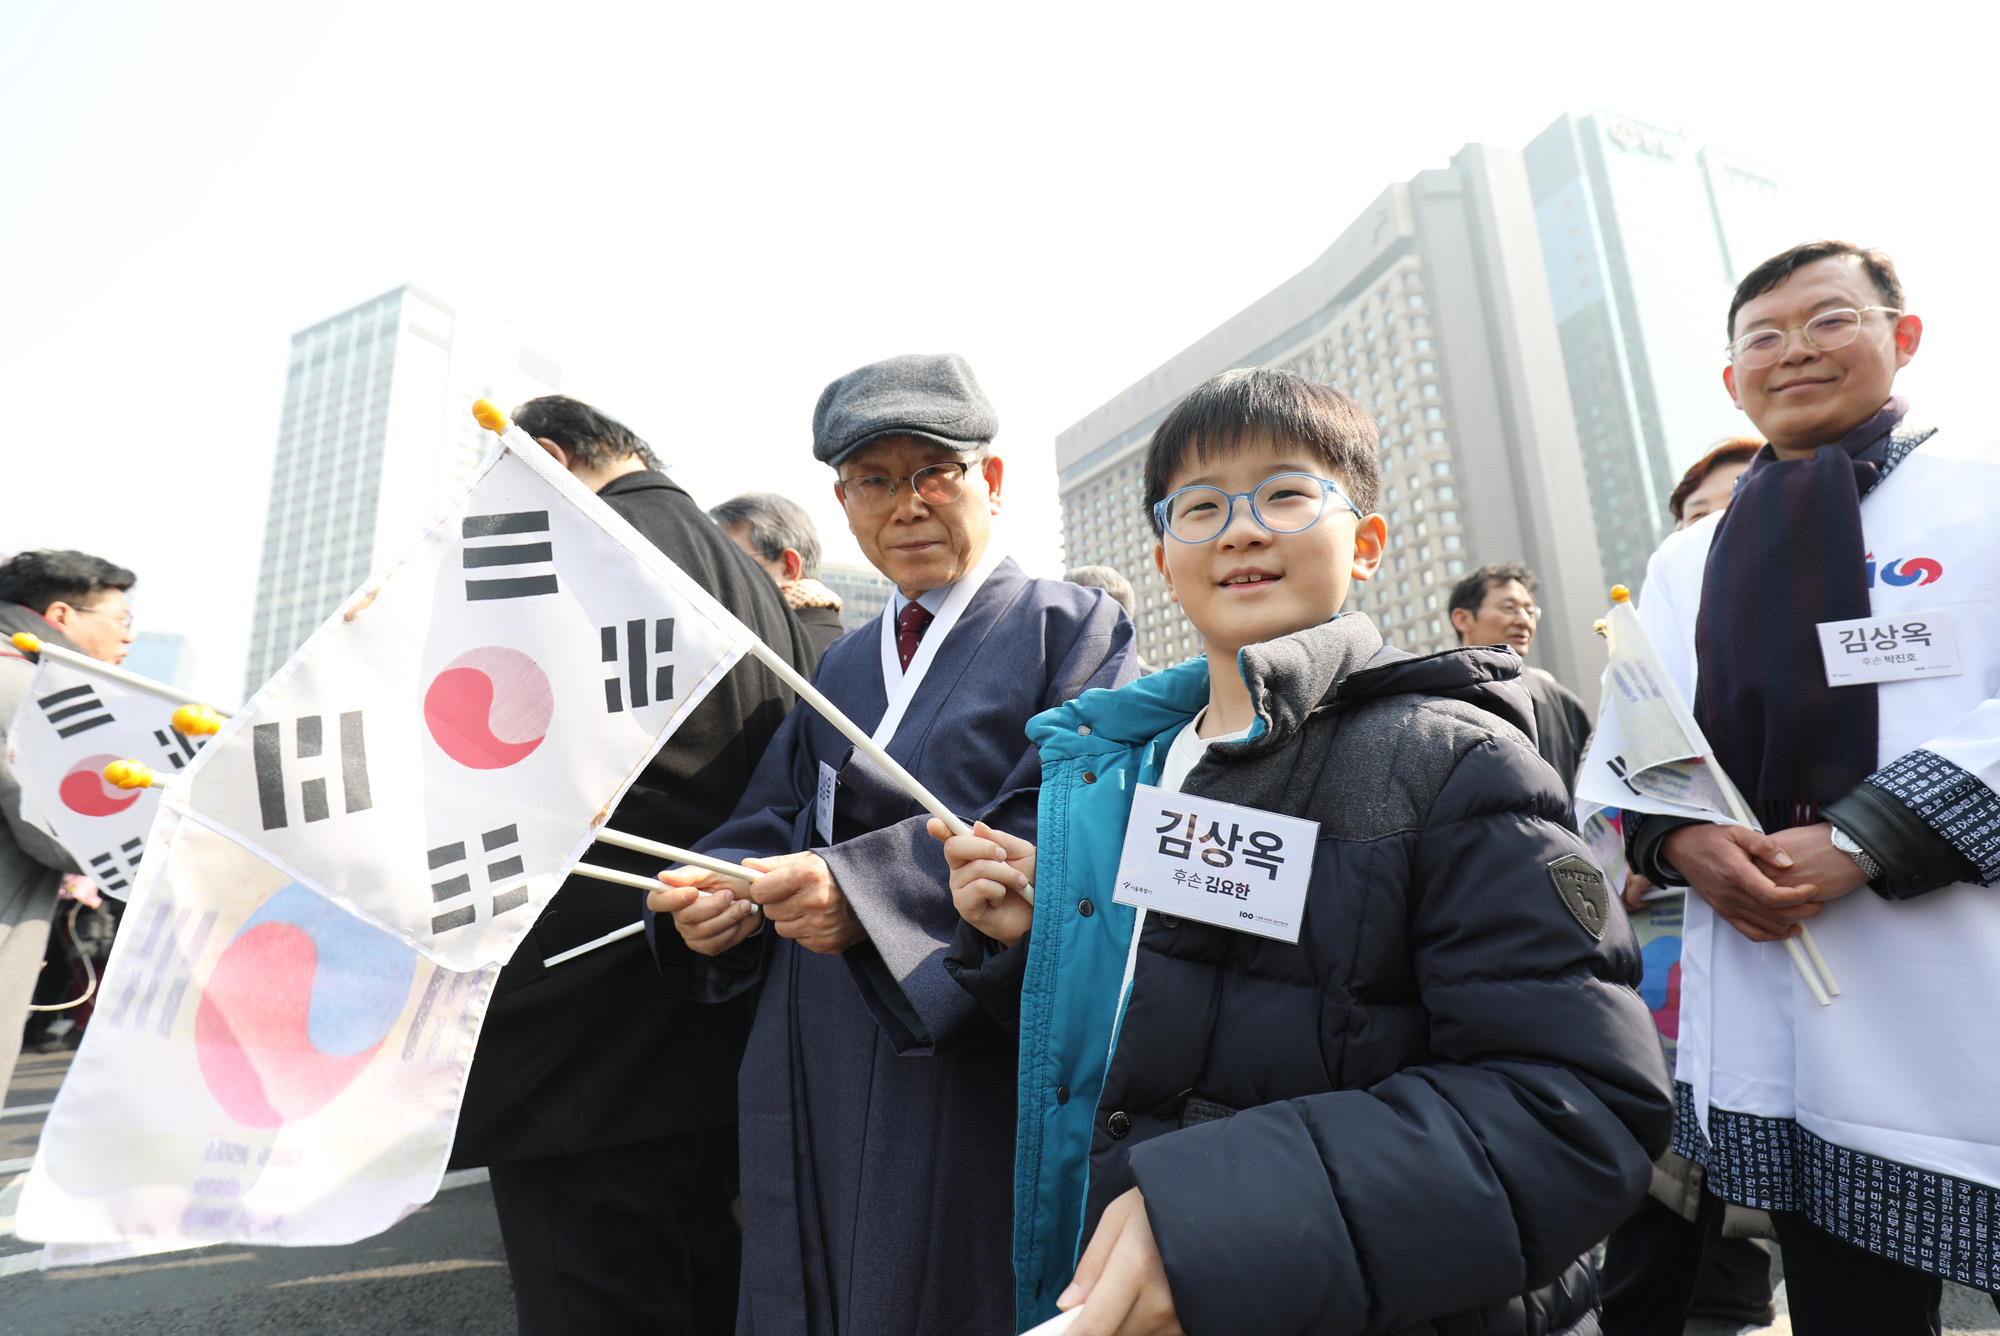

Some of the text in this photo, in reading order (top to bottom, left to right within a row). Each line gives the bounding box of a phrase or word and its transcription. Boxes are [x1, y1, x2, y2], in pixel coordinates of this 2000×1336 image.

[1839, 622, 1932, 653] 김상옥
[1862, 653, 1917, 665] 후손 박진호
[1904, 758, 1940, 781] 인류와
[1965, 806, 1988, 825] 가장
[1156, 810, 1284, 880] 김상옥
[1172, 868, 1250, 900] 후손 김요한
[1239, 911, 1254, 919] 100
[1726, 1114, 1738, 1139] 영원히
[1739, 1117, 1756, 1206] 살아갈 정당한 권리를
[1754, 1119, 1771, 1209] 후손이 민족 스스로
[1825, 1144, 1834, 1171] 일본이
[1872, 1159, 1883, 1190] 민족이
[1774, 1194, 1783, 1210] 우리
[1853, 1154, 1866, 1248] 조선과 일본의 강제
[1870, 1191, 1882, 1222] 바라지
[1887, 1163, 1900, 1260] 것이다. 처음부터 우리
[1903, 1170, 1918, 1266] 세상으로 되돌리려는
[1921, 1174, 1936, 1272] 자연스럽고 올바른
[1957, 1183, 1971, 1283] 공명심으로 희생시킨
